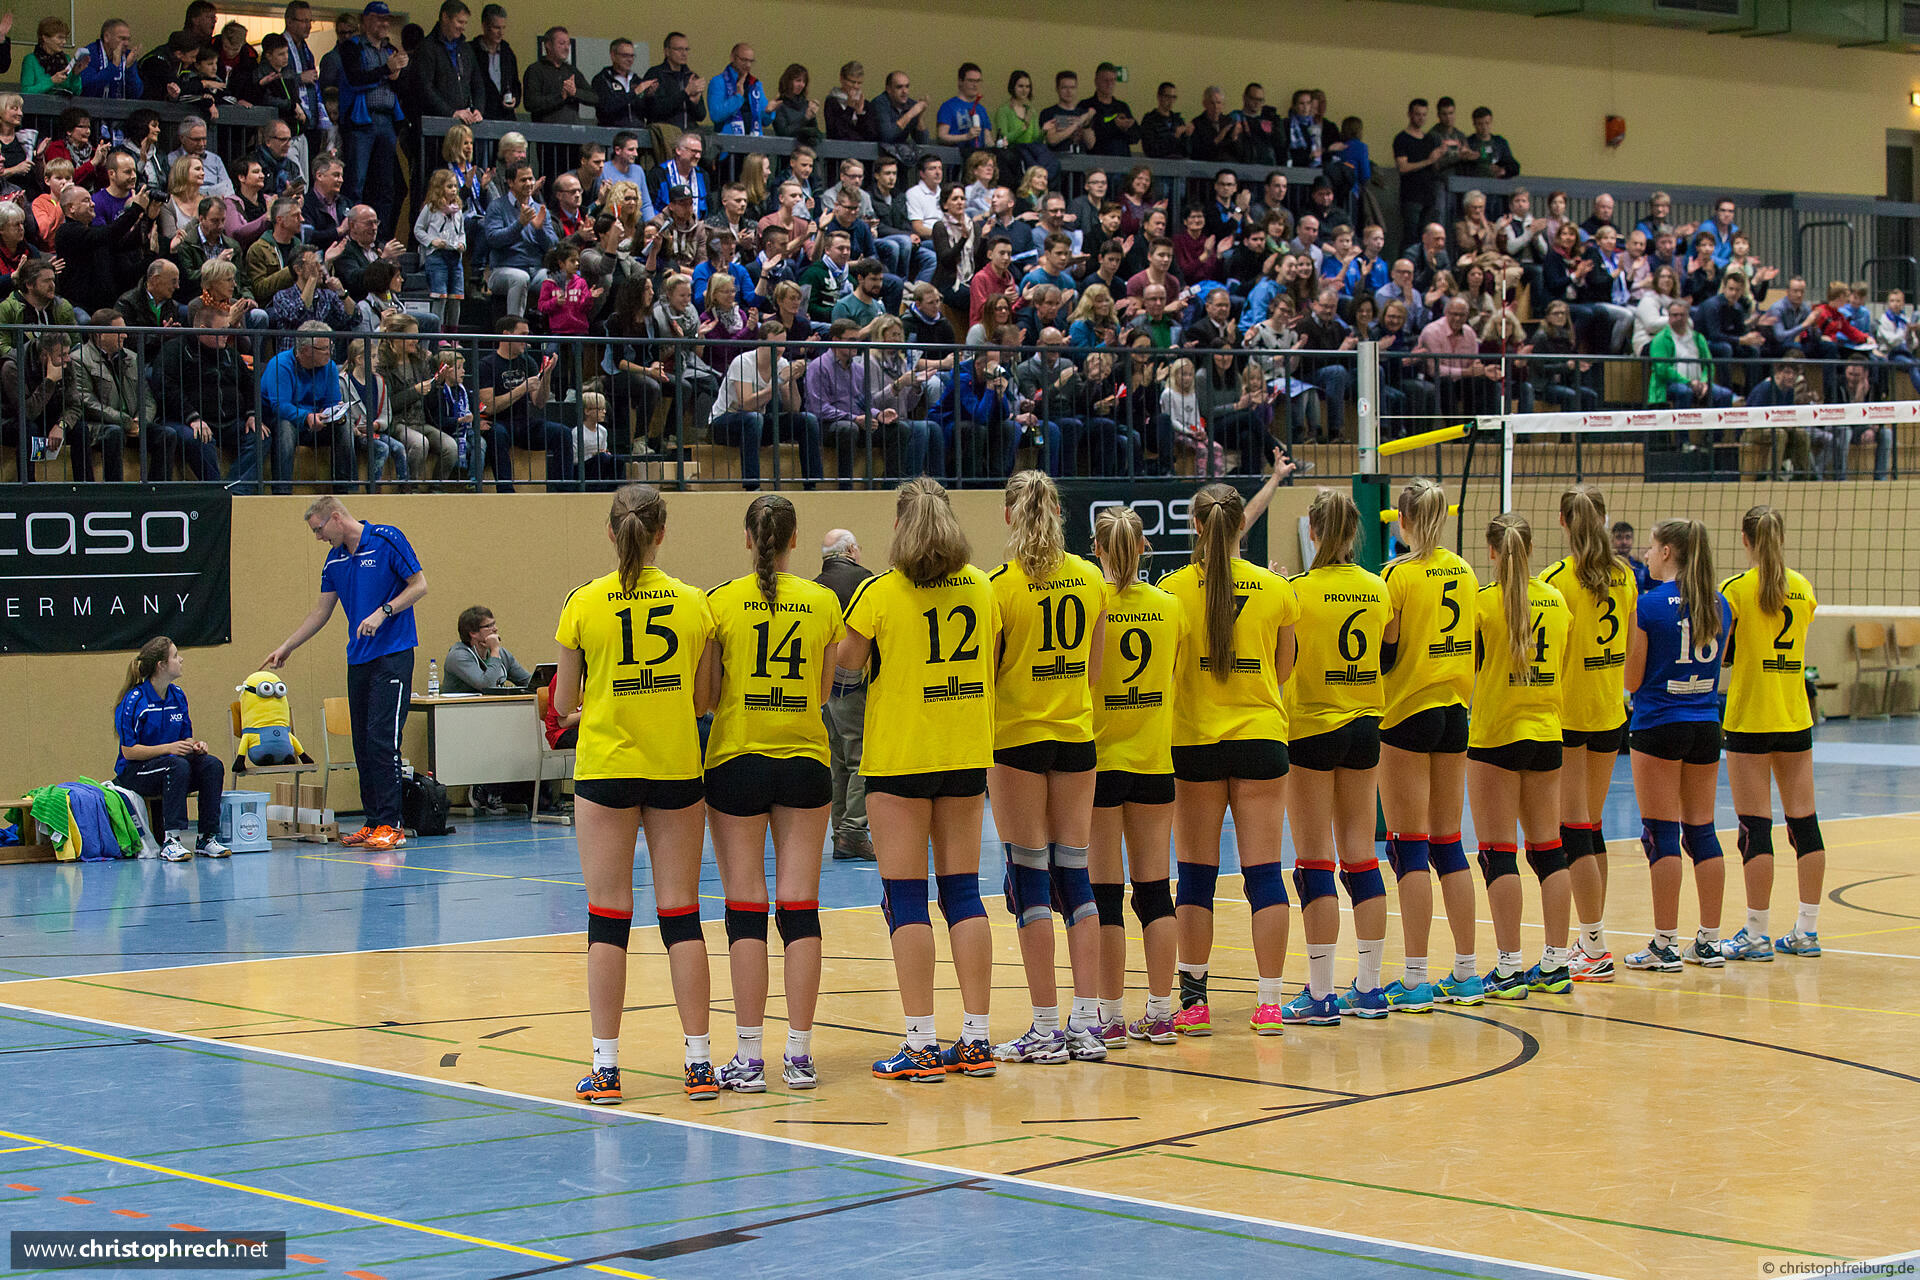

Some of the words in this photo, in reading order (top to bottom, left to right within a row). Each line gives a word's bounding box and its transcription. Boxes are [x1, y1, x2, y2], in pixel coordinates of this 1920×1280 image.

[607, 588, 679, 602] PROVINZIAL
[1105, 612, 1165, 623] ROVINZIAL
[1324, 593, 1381, 603] PROVINZIAL
[1440, 579, 1461, 633] 5
[1596, 596, 1619, 646] 3
[614, 604, 679, 666] 15
[750, 620, 807, 680] 14
[922, 605, 980, 664] 12
[1037, 594, 1086, 652] 10
[1338, 608, 1368, 662] 6
[1773, 604, 1795, 650] 2
[1119, 628, 1152, 684] 9
